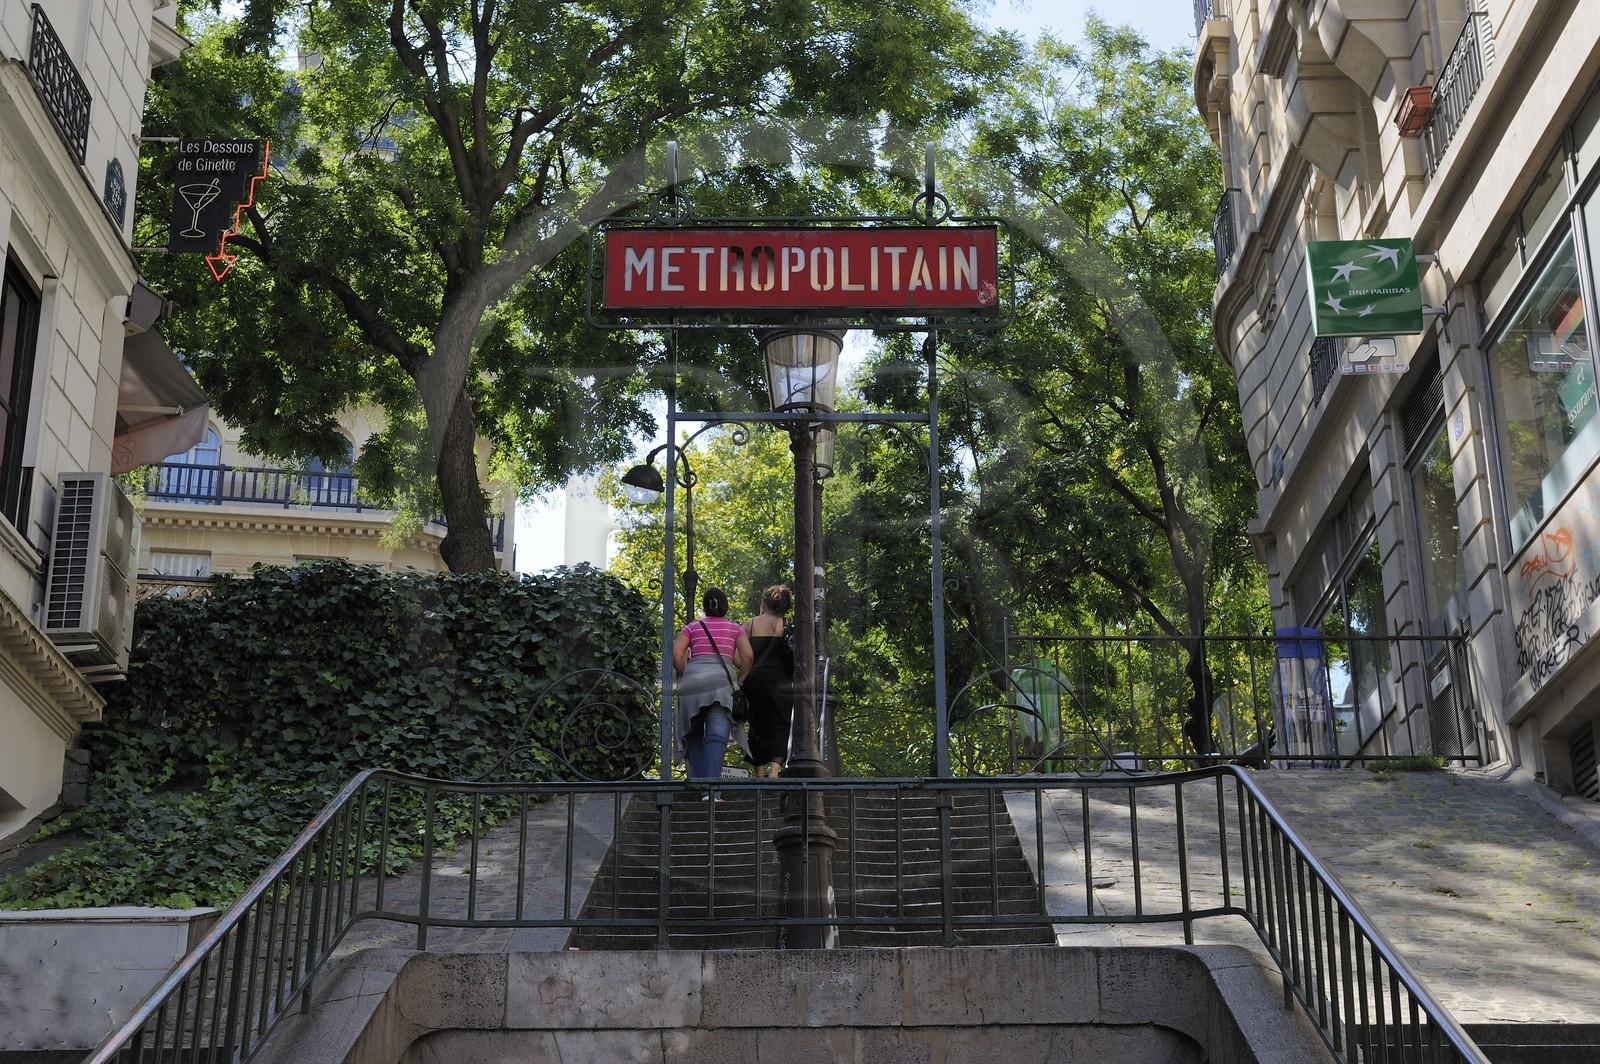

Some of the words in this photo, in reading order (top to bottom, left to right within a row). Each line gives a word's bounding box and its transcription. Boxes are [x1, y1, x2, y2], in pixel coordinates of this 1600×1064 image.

[180, 140, 200, 153] Les
[203, 140, 254, 154] Dessous
[178, 158, 192, 171] de
[195, 157, 236, 171] Ginette
[624, 245, 978, 292] METROPOLITAIN
[1370, 287, 1411, 295] PARIBAS
[1577, 366, 1585, 385] et
[1568, 382, 1596, 423] ssuranc
